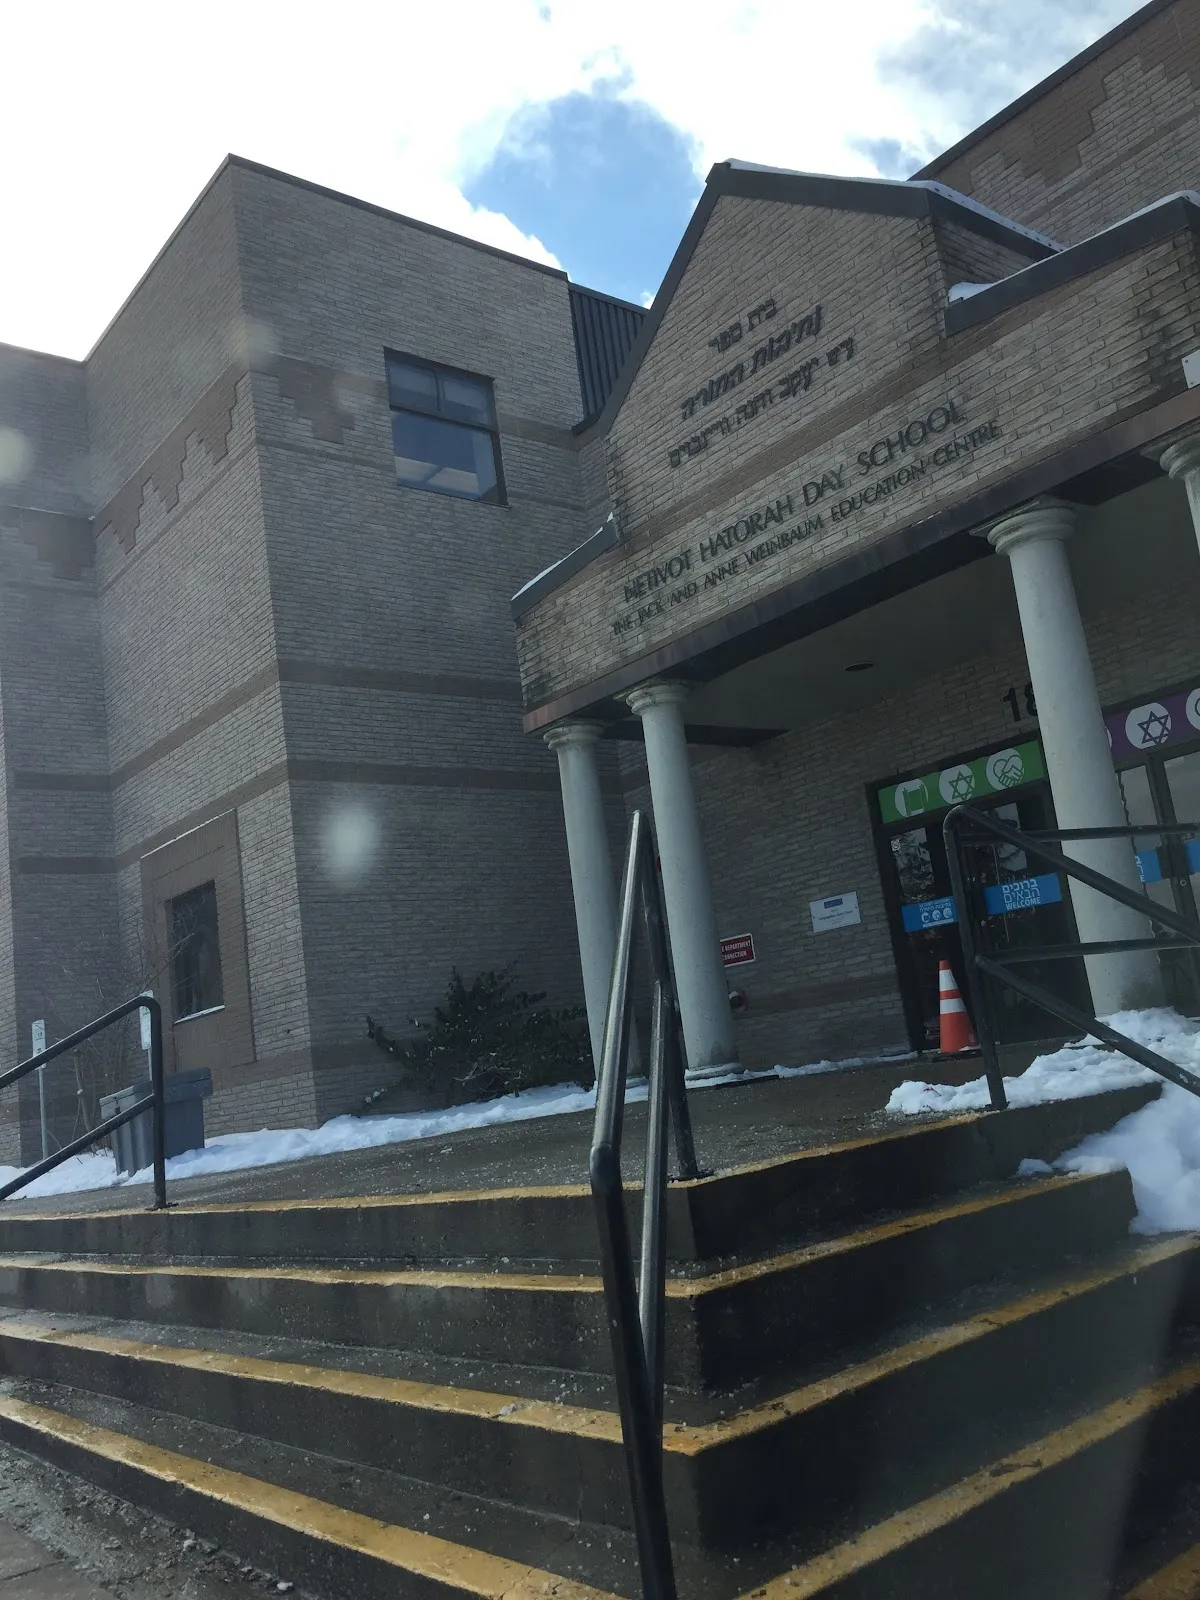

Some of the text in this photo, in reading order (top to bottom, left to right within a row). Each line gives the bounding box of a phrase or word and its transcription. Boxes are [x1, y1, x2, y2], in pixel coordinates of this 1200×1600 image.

[708, 298, 777, 353] בית ספר
[681, 304, 824, 421] נתיבות התורה
[779, 357, 819, 399] יעקב
[623, 398, 967, 603] NETIVOT HATORAH DAY SCHOOL
[611, 419, 1003, 635] THE JACK AND ANNE WEINBAUM EDUCATION CENTRE
[1001, 878, 1039, 894] ברוכים
[1003, 887, 1041, 904] הבאים
[1005, 896, 1042, 910] WELCOME
[725, 940, 751, 951] DEPARTMENT
